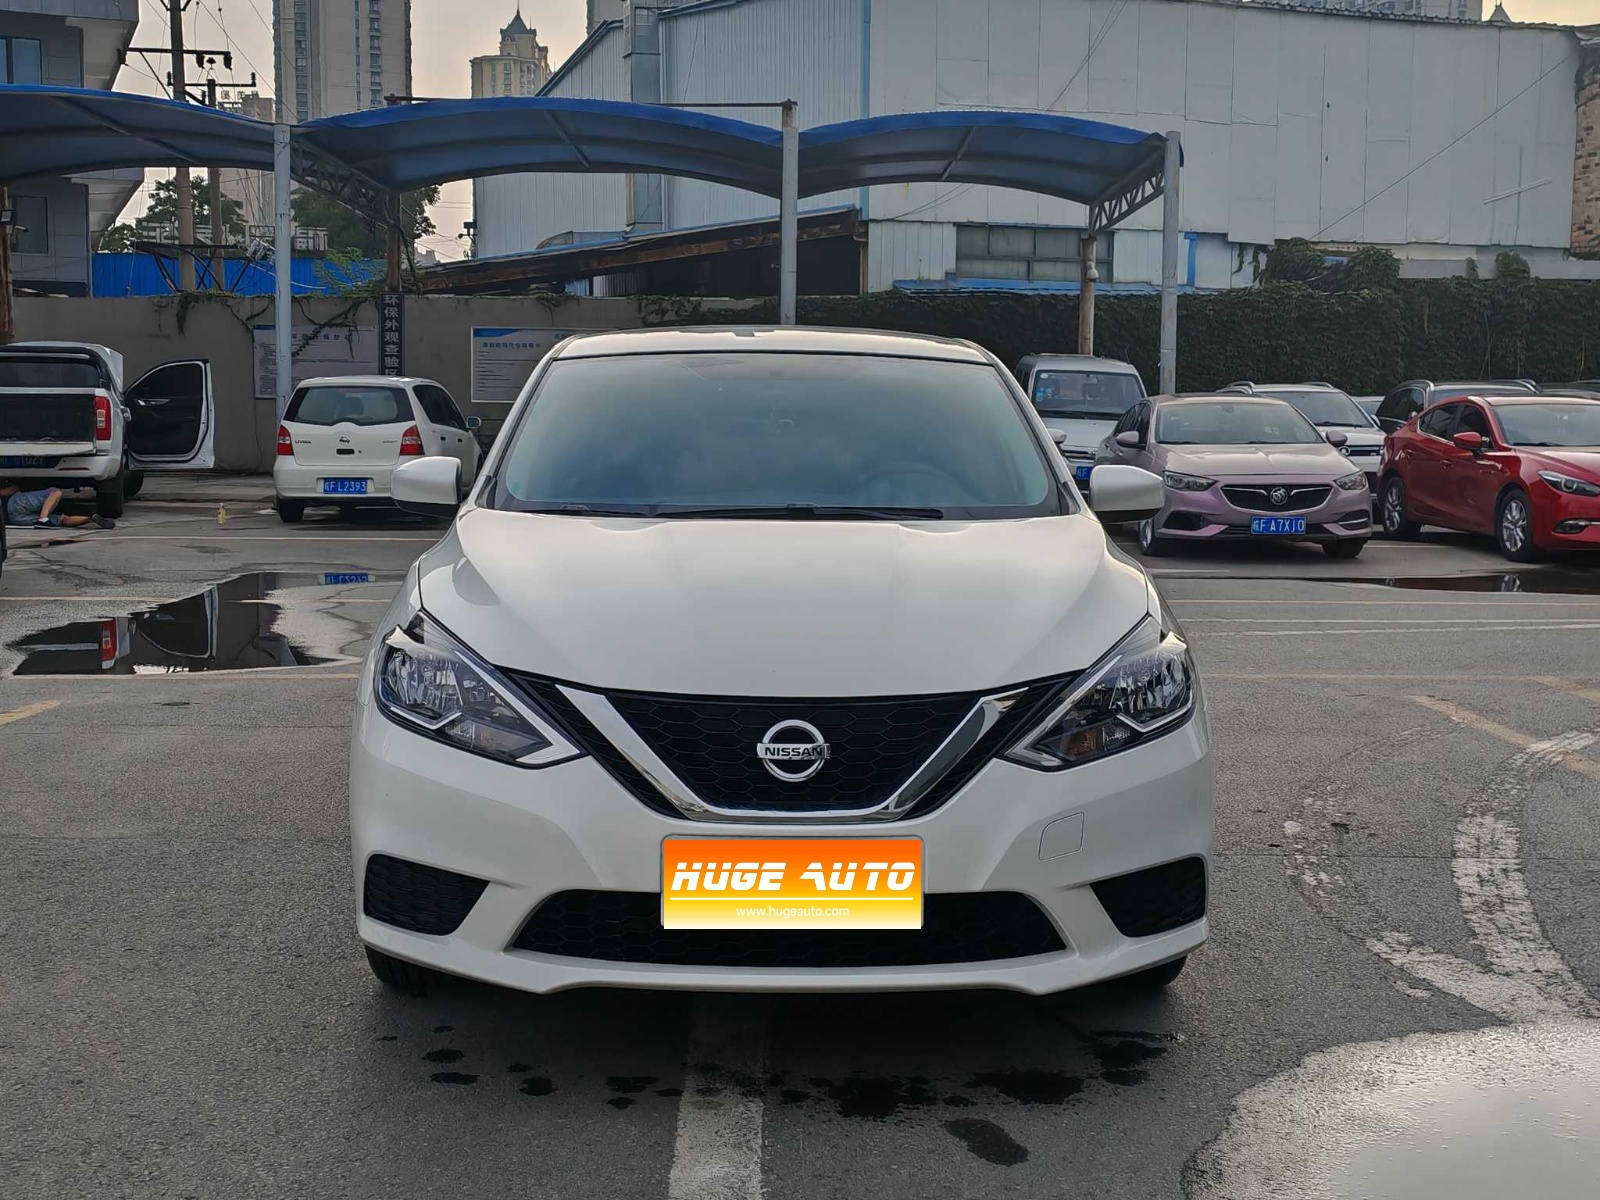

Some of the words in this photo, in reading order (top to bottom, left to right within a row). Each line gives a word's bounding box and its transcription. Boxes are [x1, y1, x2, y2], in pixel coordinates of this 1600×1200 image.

[383, 294, 400, 376] 环保外观查验区
[337, 481, 366, 492] L2393
[765, 746, 823, 757] NISSAN
